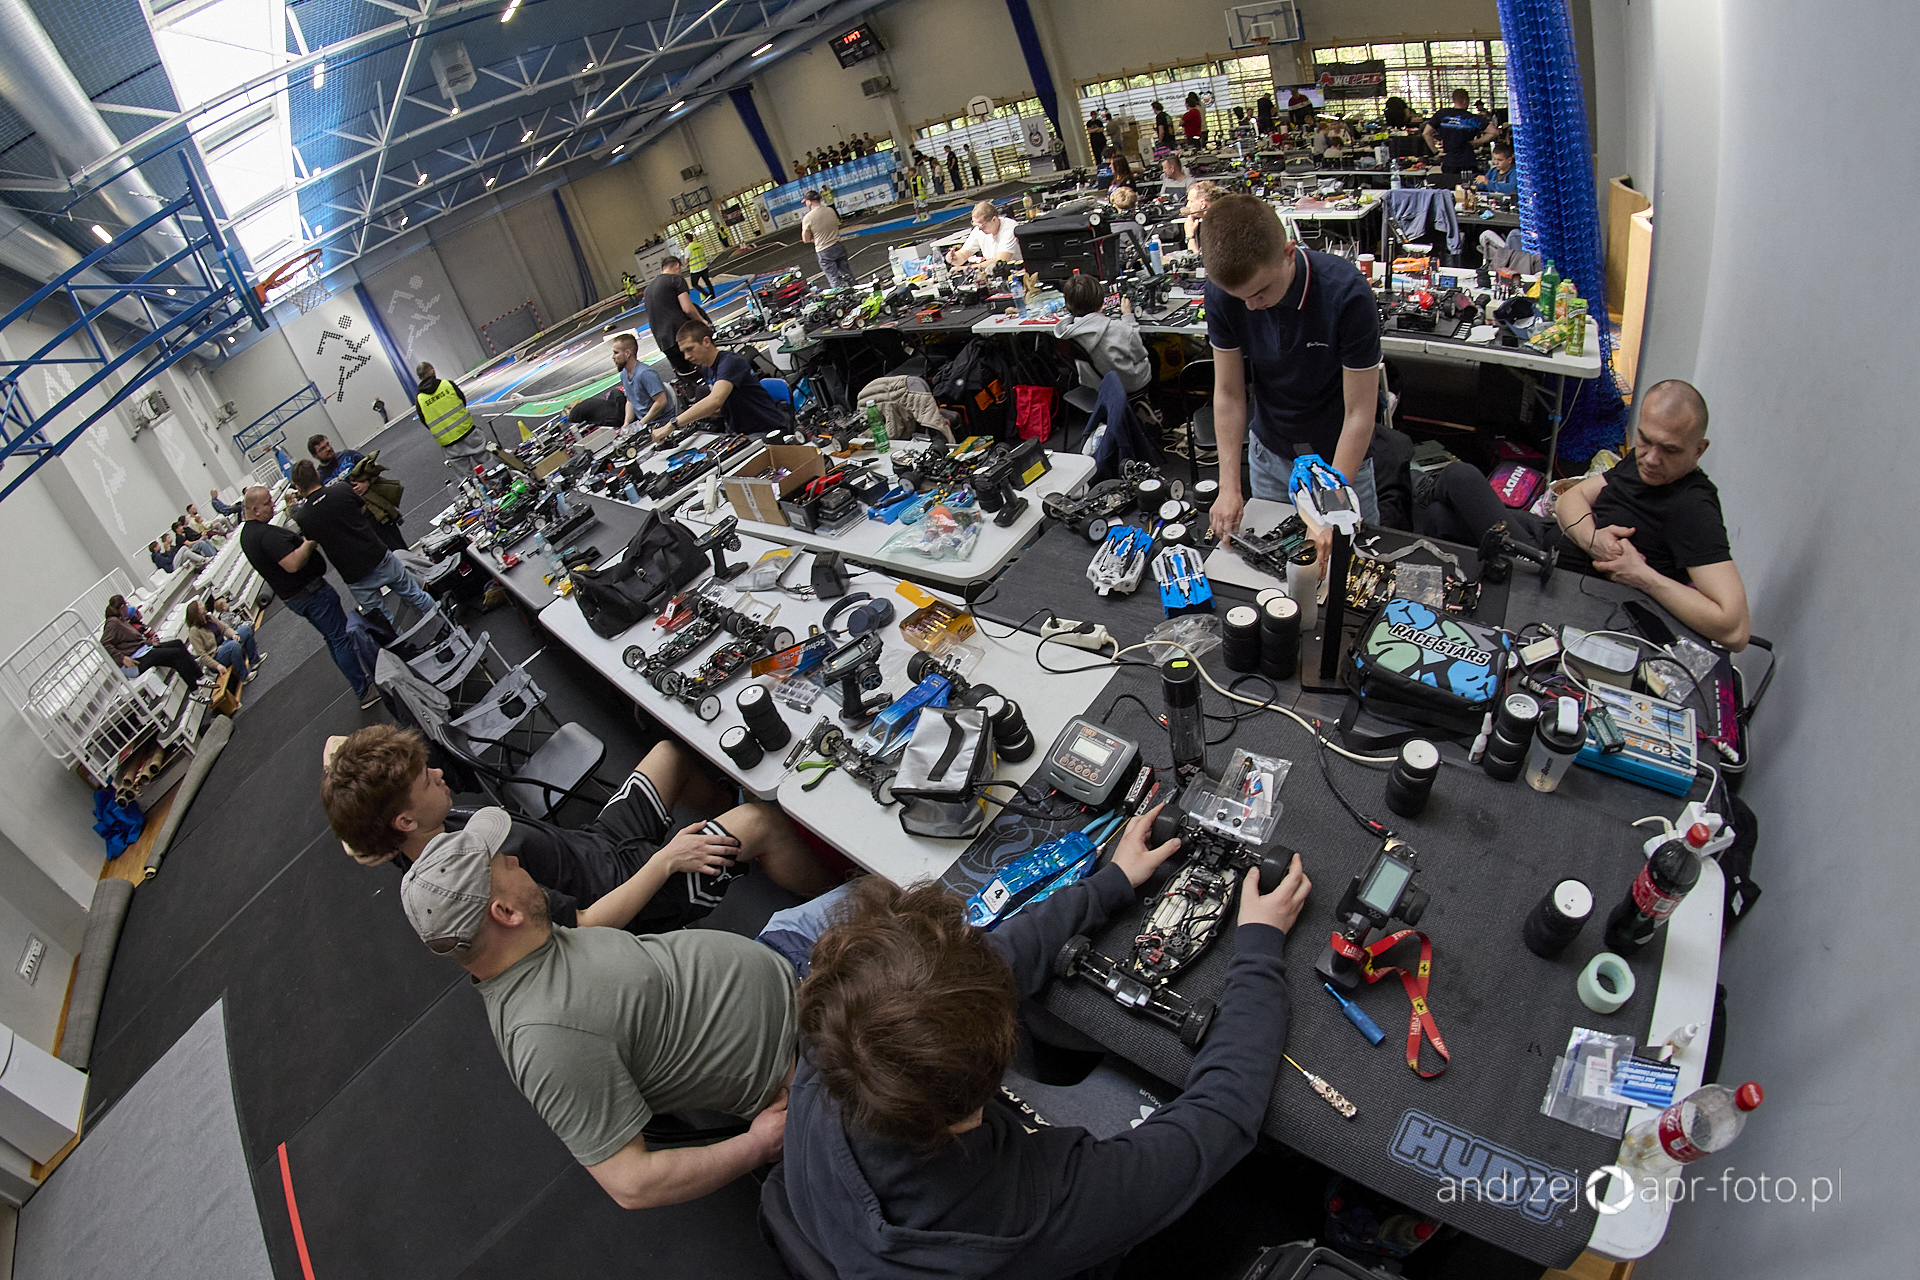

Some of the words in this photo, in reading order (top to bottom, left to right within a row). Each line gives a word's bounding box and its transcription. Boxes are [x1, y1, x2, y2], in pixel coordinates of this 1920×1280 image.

[1502, 465, 1527, 498] HUDY
[1389, 623, 1435, 650] RACE
[1433, 637, 1492, 666] STARS
[994, 888, 1005, 900] 4
[1392, 1112, 1578, 1220] HUDY
